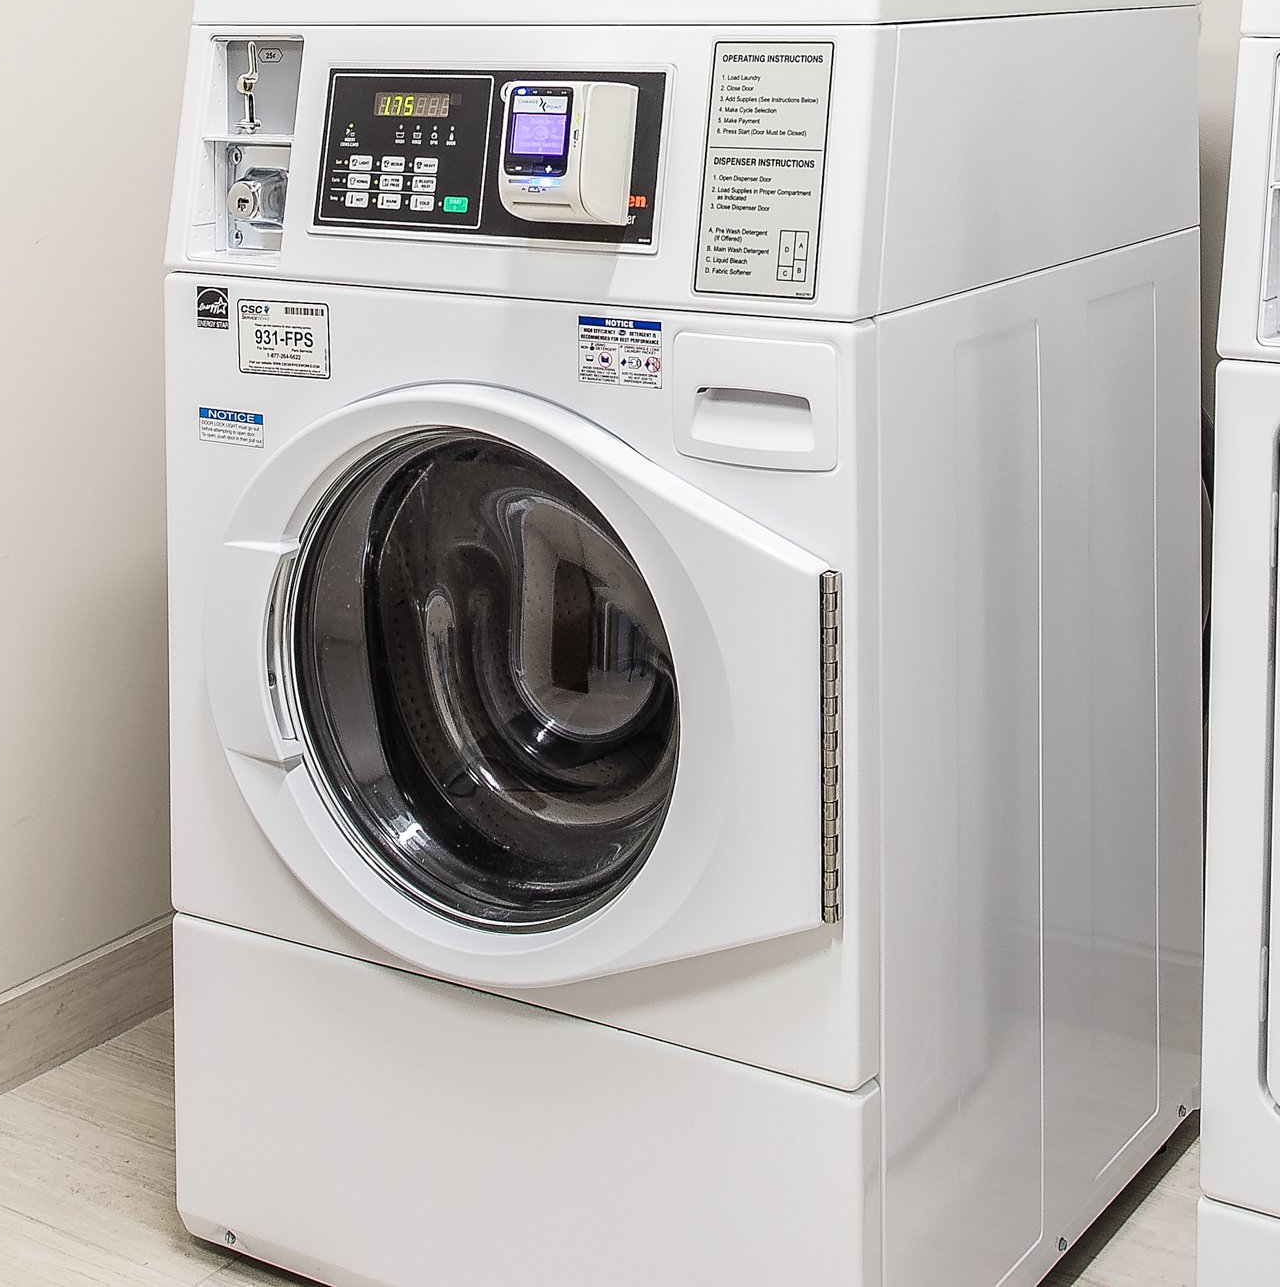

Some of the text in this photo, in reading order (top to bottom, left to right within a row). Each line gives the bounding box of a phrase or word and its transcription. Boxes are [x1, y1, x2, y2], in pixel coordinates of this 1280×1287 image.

[768, 55, 823, 63] INSTRUCTIONS
[714, 157, 814, 168] DISPENSER INSTRUCTIONS
[241, 305, 262, 314] CSC
[605, 319, 634, 328] NOTICE
[255, 330, 313, 347] 931-FPS
[208, 410, 255, 423] NOTICE
